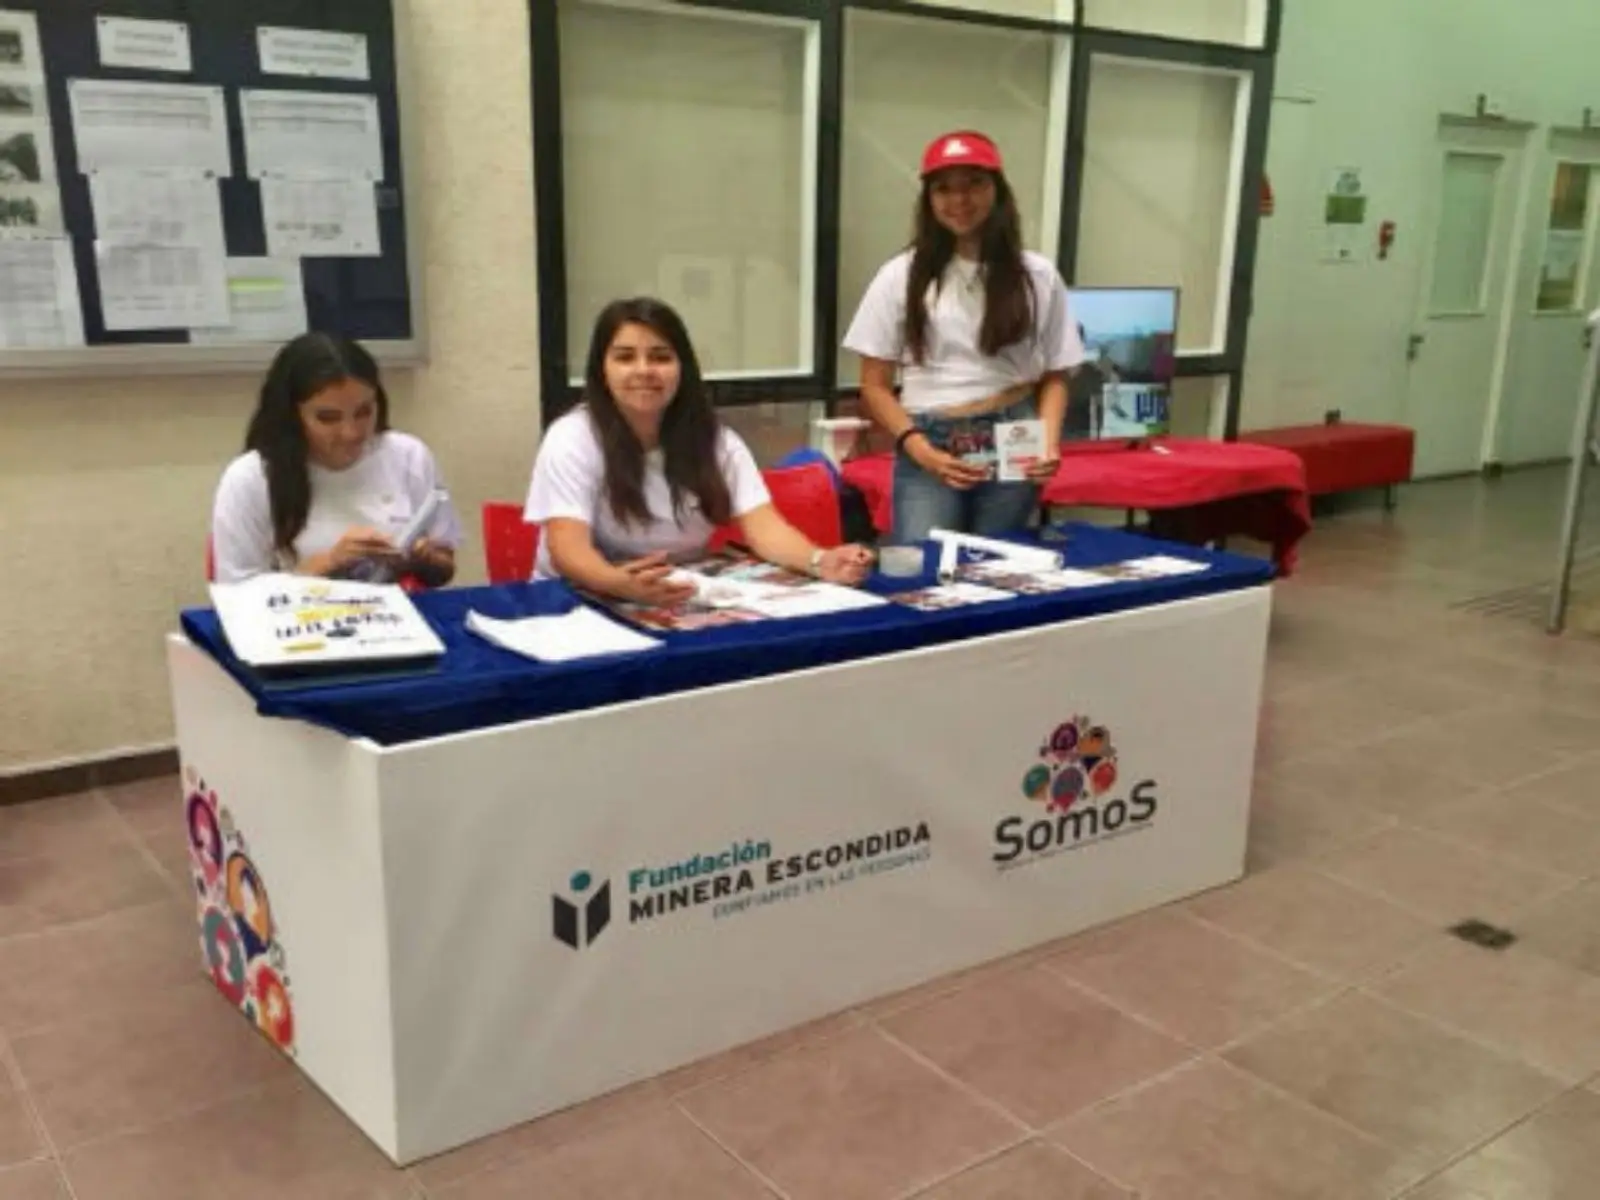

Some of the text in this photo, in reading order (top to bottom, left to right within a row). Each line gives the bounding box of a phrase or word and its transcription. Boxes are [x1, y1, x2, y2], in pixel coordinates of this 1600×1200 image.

[628, 838, 772, 894] Fundación
[628, 869, 754, 923] MINERA
[766, 822, 931, 884] ESCONDIDA
